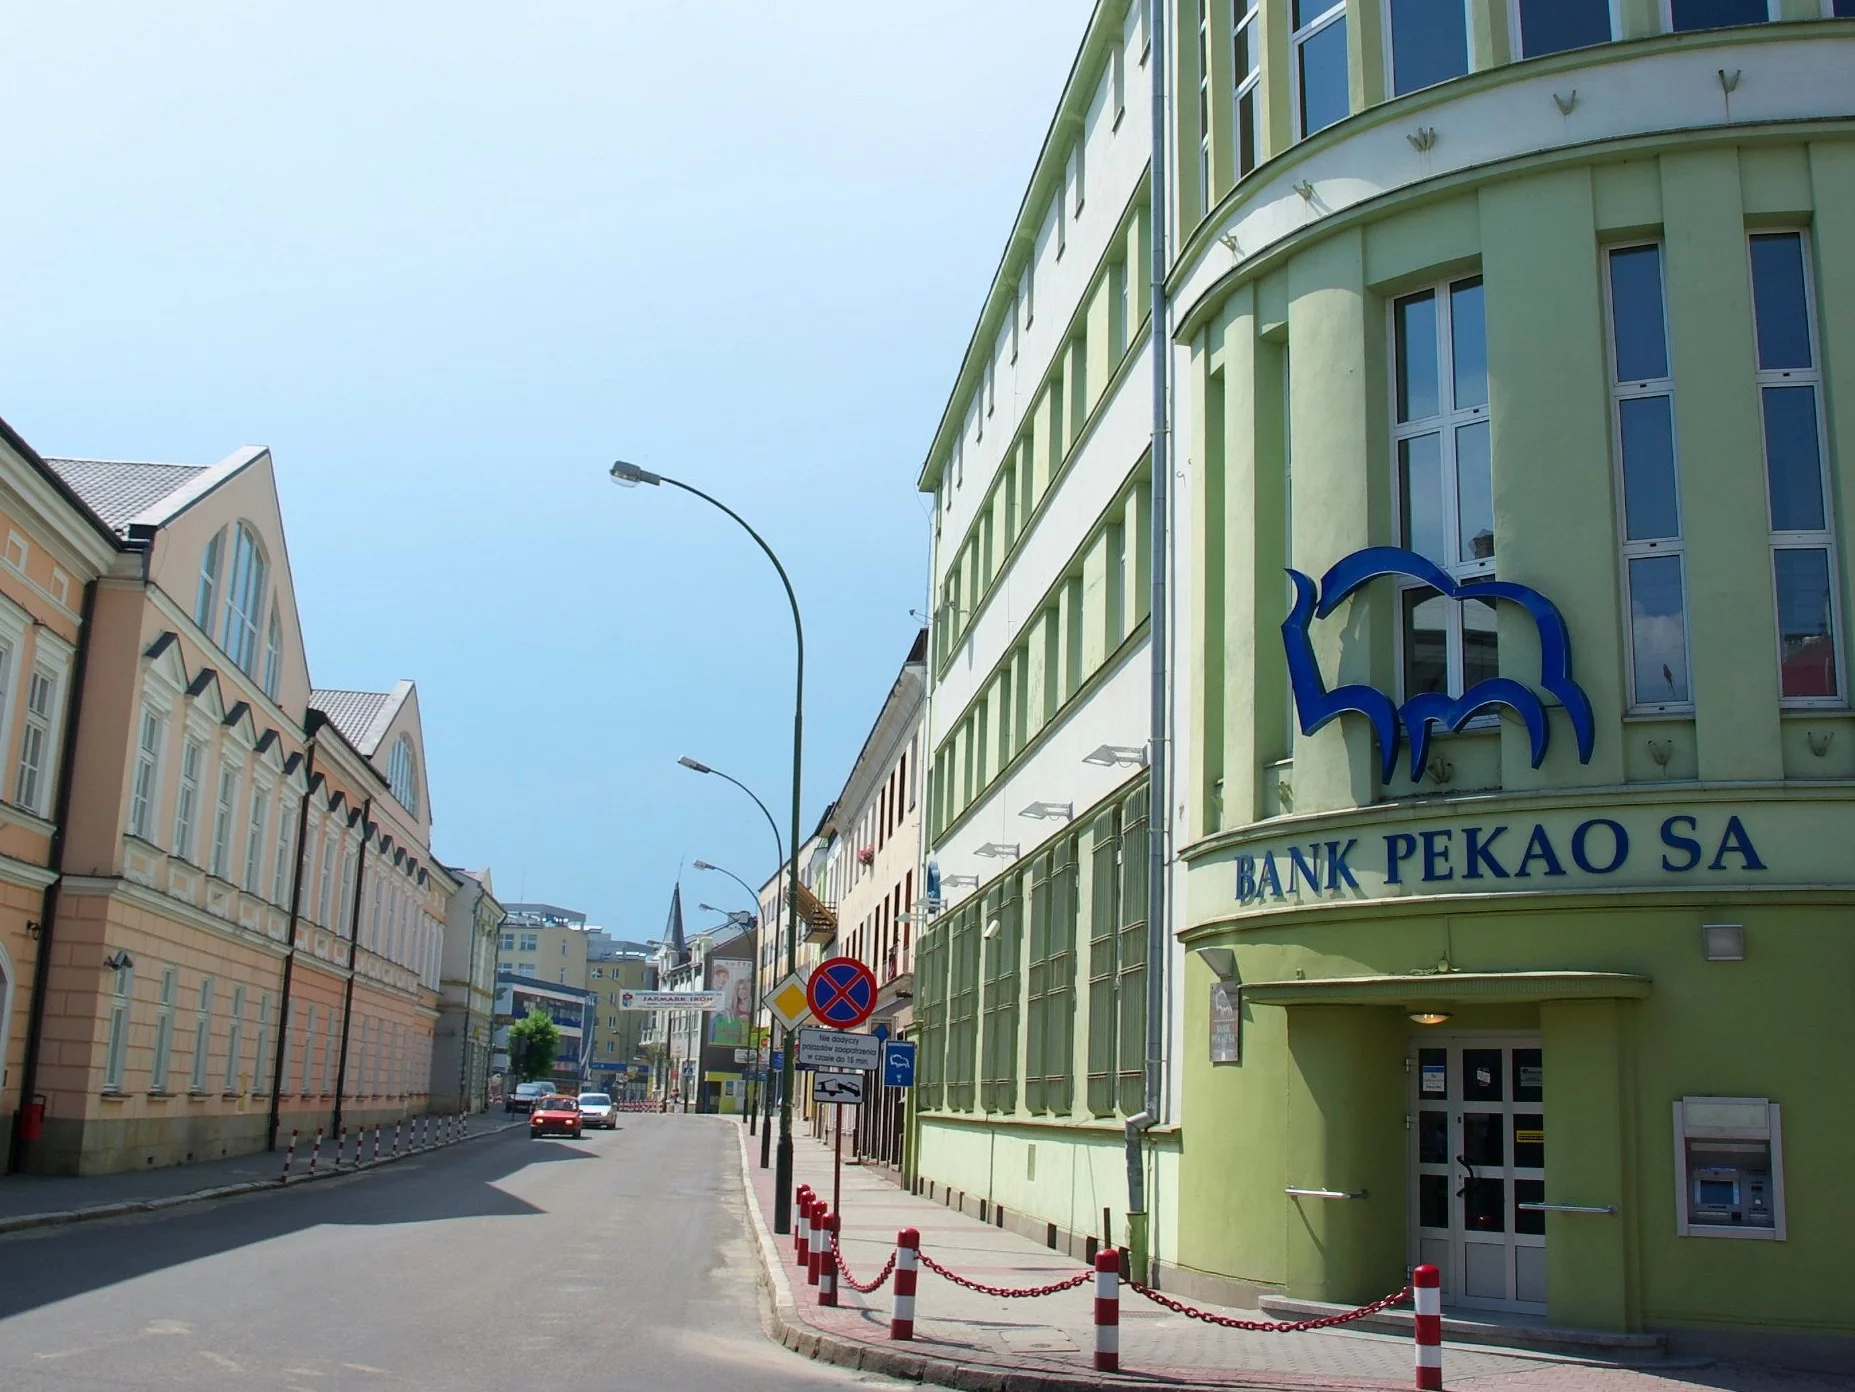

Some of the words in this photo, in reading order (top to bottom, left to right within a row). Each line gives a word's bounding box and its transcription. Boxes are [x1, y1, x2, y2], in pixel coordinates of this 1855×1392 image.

[1235, 838, 1360, 901] BANK
[1382, 818, 1630, 884] PEKAO
[1660, 815, 1768, 871] SA
[834, 1046, 877, 1056] zaopatrzenia
[814, 1054, 834, 1062] czasie
[835, 1055, 845, 1063] do
